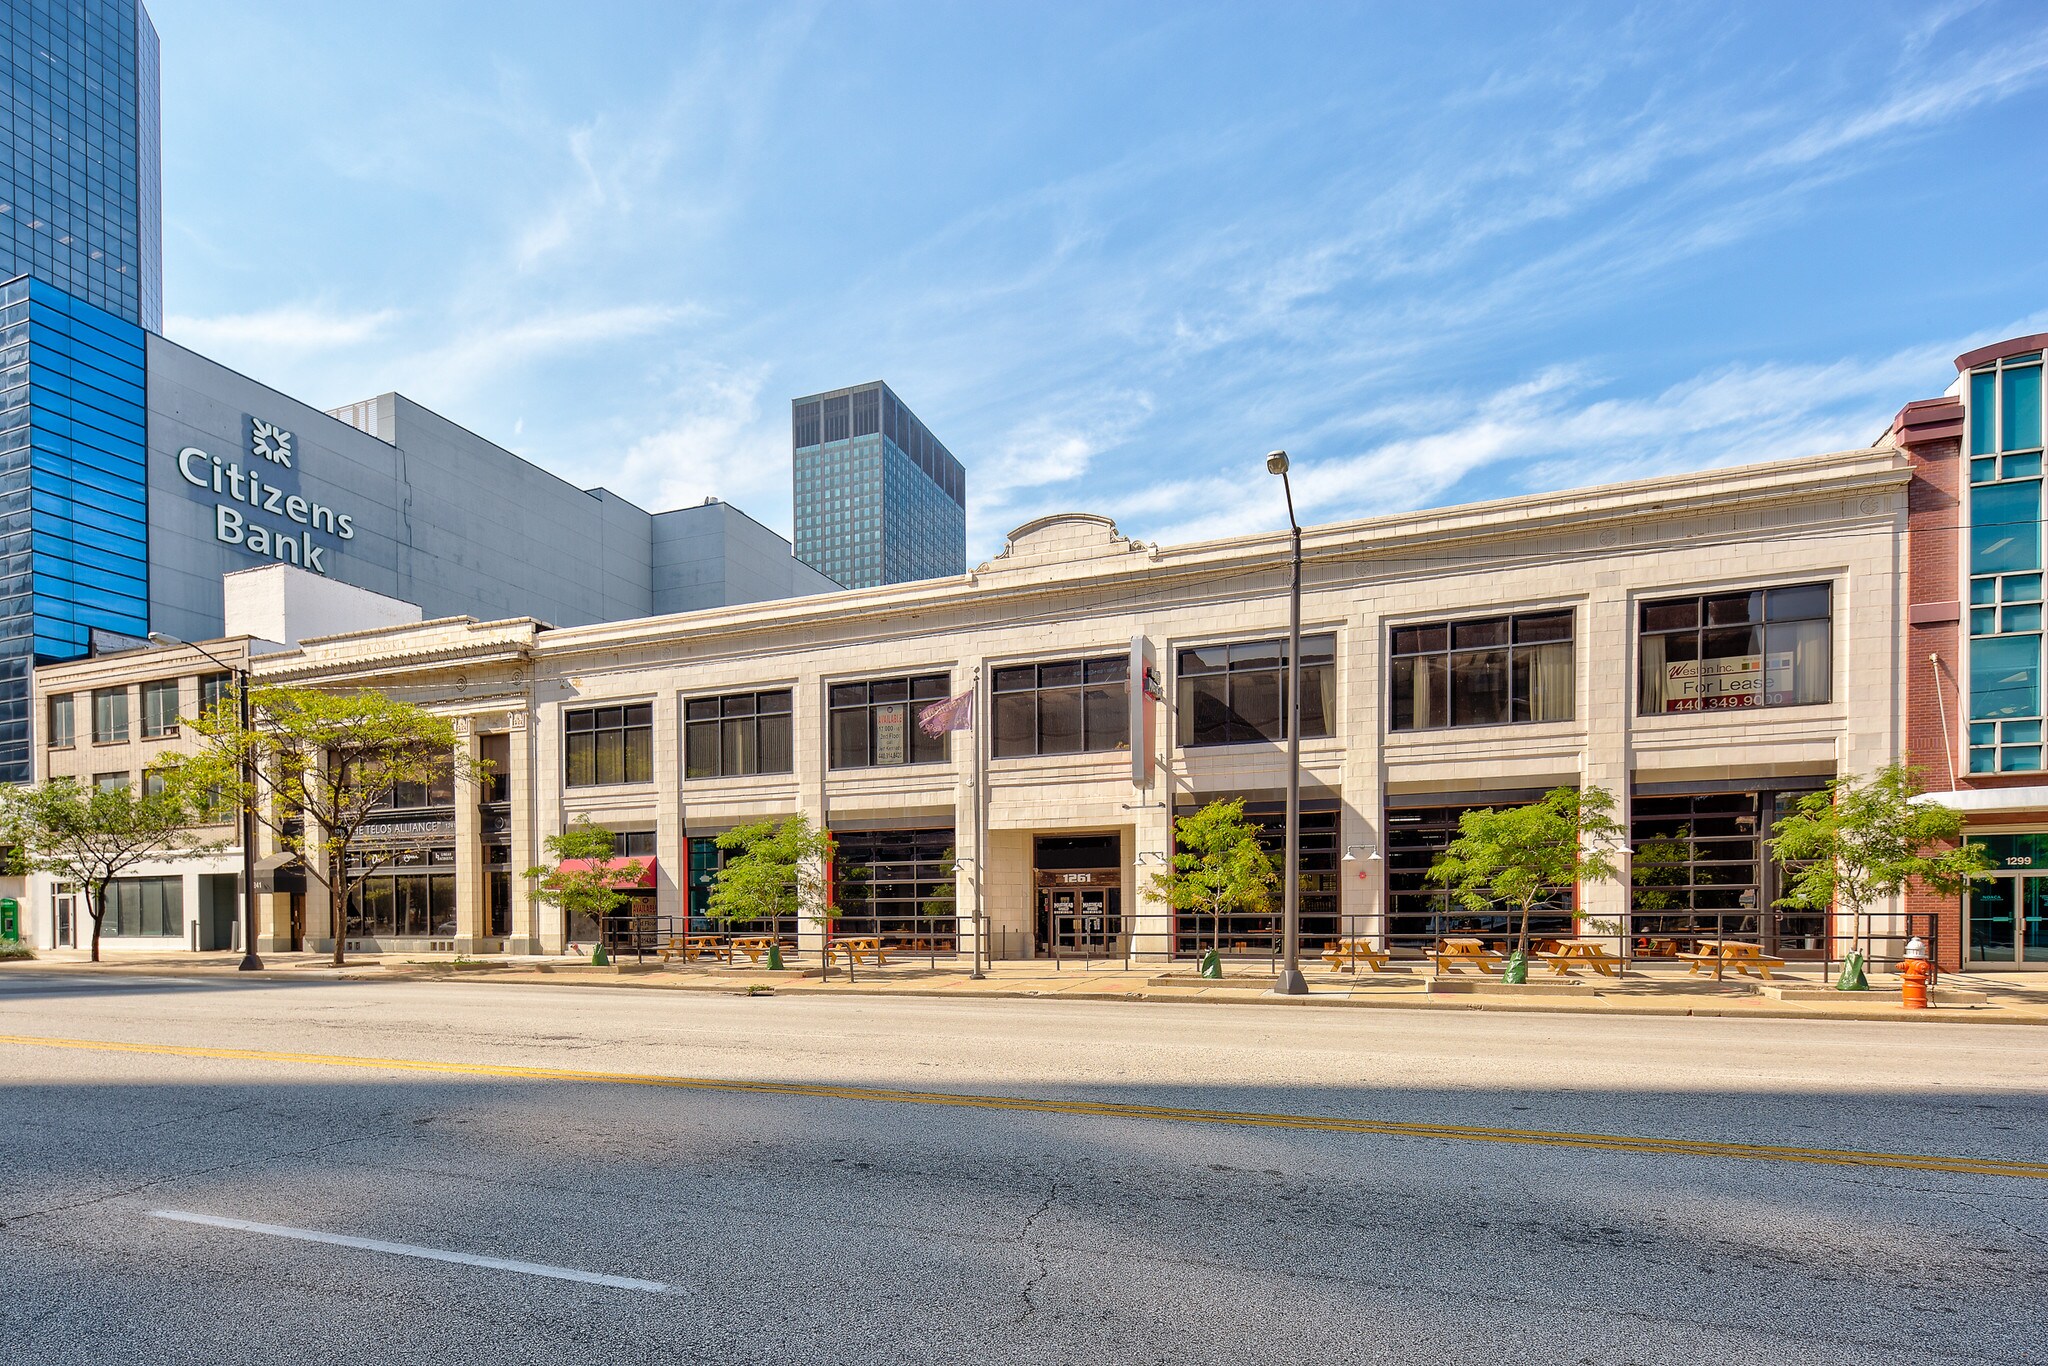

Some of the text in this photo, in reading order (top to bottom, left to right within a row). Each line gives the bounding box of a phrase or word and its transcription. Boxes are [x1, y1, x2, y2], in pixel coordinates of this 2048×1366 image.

[178, 447, 354, 540] Citizens
[216, 504, 325, 573] Bank
[1716, 664, 1734, 673] Inc.
[1683, 676, 1775, 695] For Lease
[1674, 693, 1783, 711] 440.349.9000
[878, 713, 903, 724] AVAILABLE
[365, 823, 392, 835] TELOS
[394, 821, 438, 833] ALLIANCE
[2005, 856, 2032, 866] 1299
[1062, 873, 1091, 883] 1261
